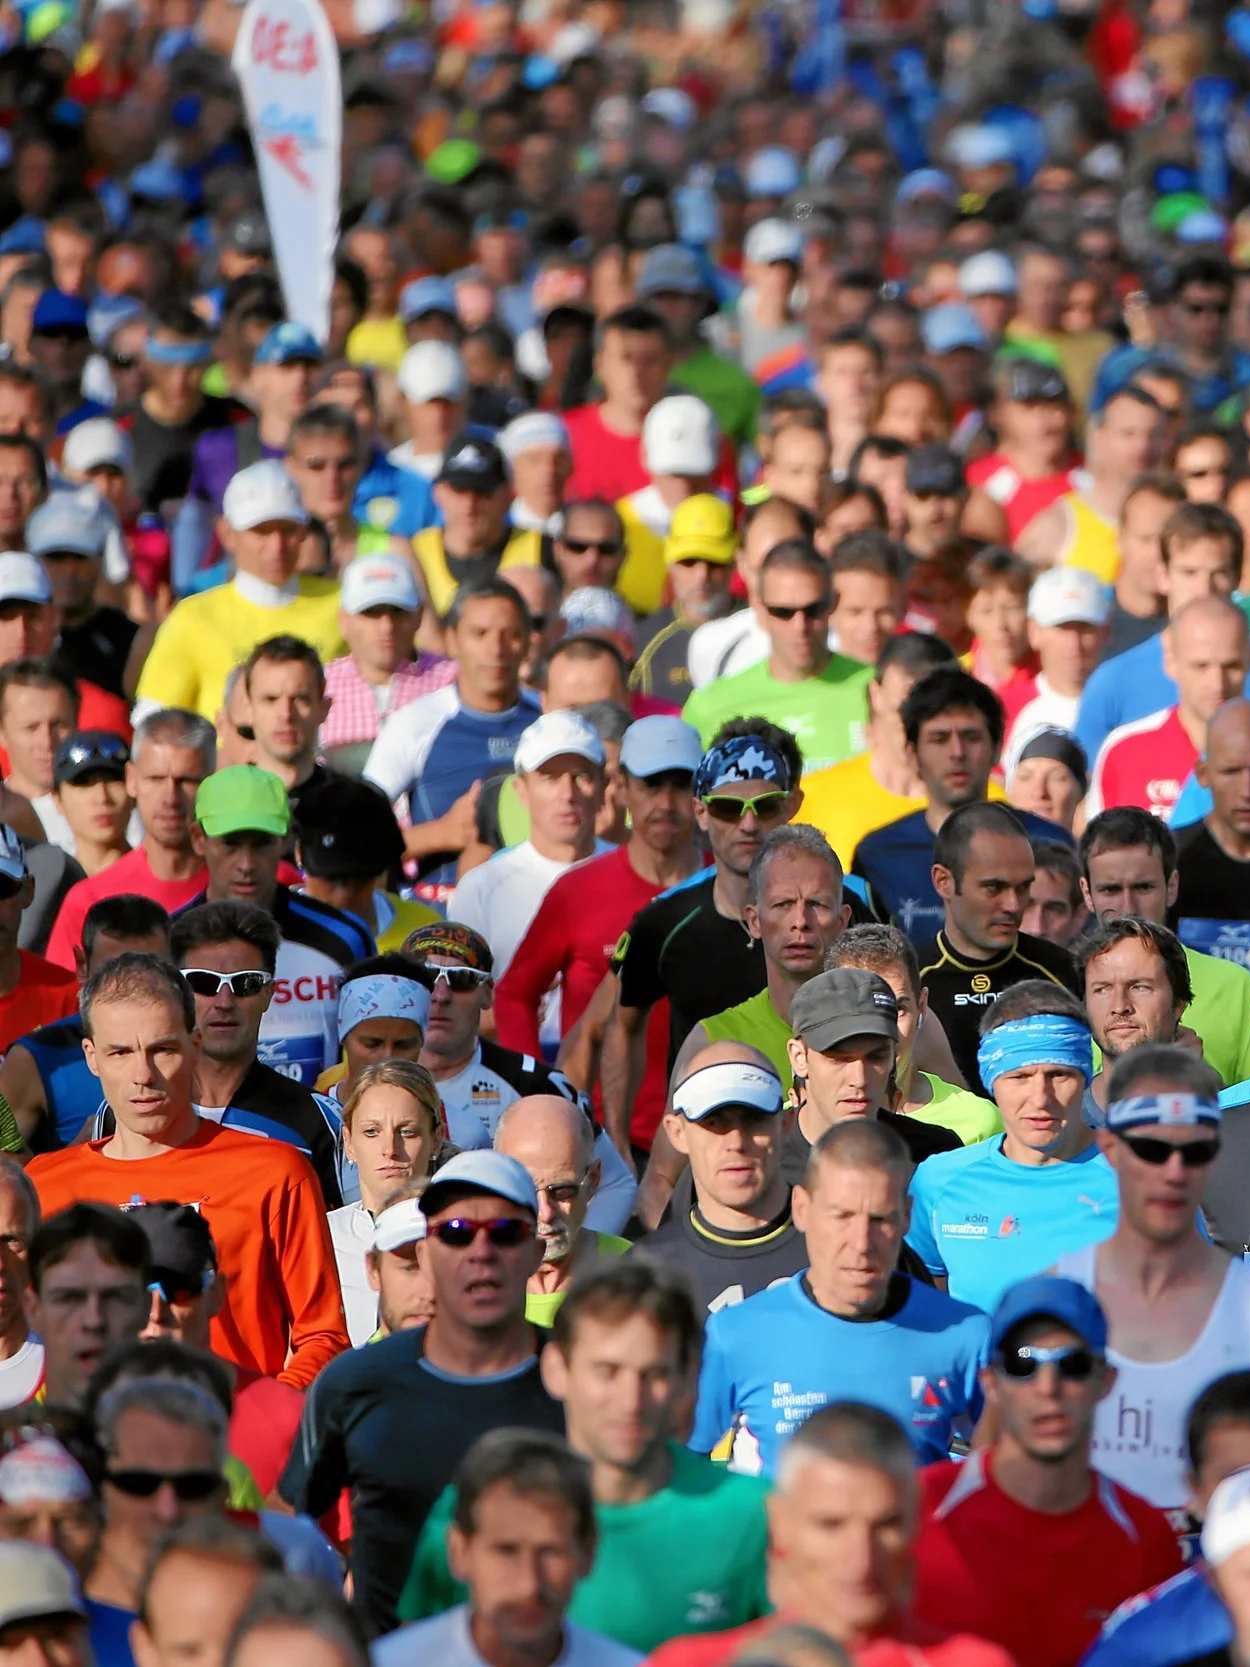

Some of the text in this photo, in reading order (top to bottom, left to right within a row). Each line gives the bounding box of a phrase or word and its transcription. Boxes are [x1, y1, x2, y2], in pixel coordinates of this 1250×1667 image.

[964, 1213, 989, 1223] köln
[941, 1224, 988, 1234] marathon
[773, 1382, 792, 1396] Am
[1118, 1394, 1152, 1447] hj
